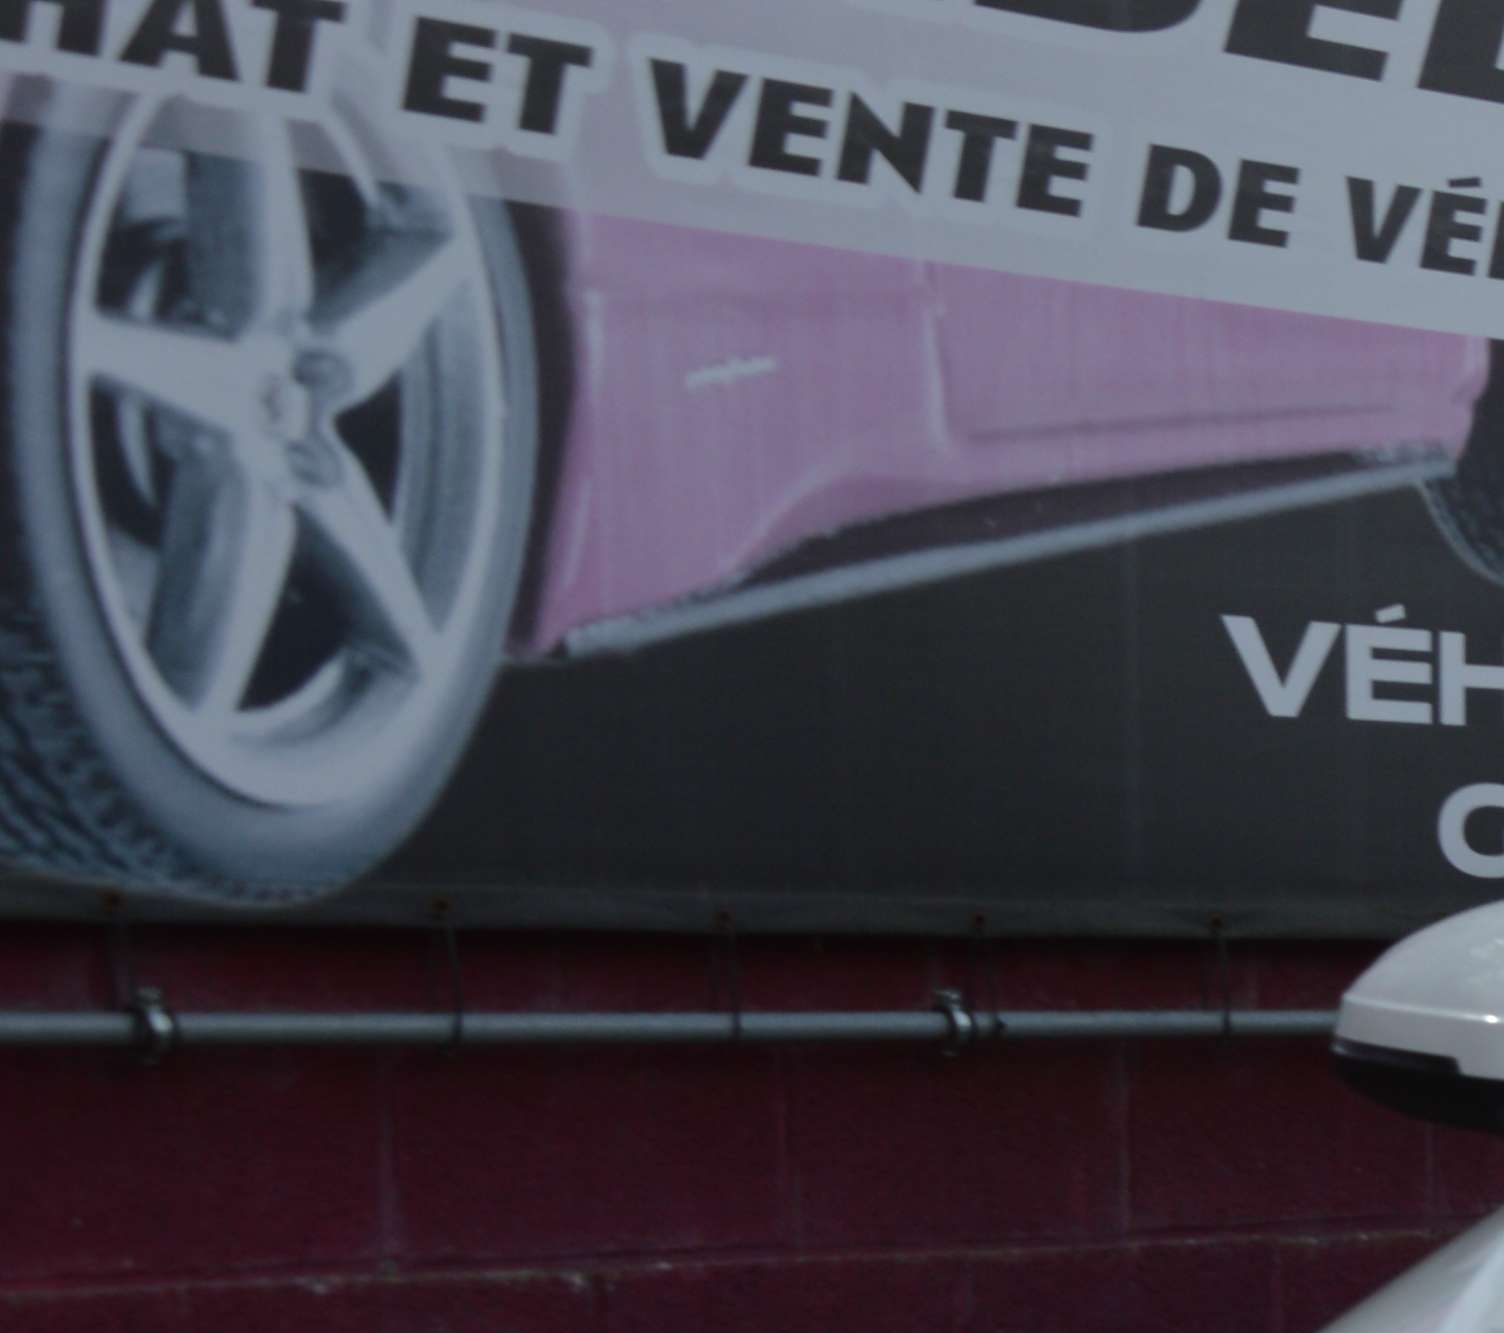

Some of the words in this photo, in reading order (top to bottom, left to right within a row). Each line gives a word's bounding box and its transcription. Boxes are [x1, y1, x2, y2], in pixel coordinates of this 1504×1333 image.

[402, 15, 592, 135] ET
[648, 56, 1094, 218] VENTE
[1136, 142, 1301, 249] DE
